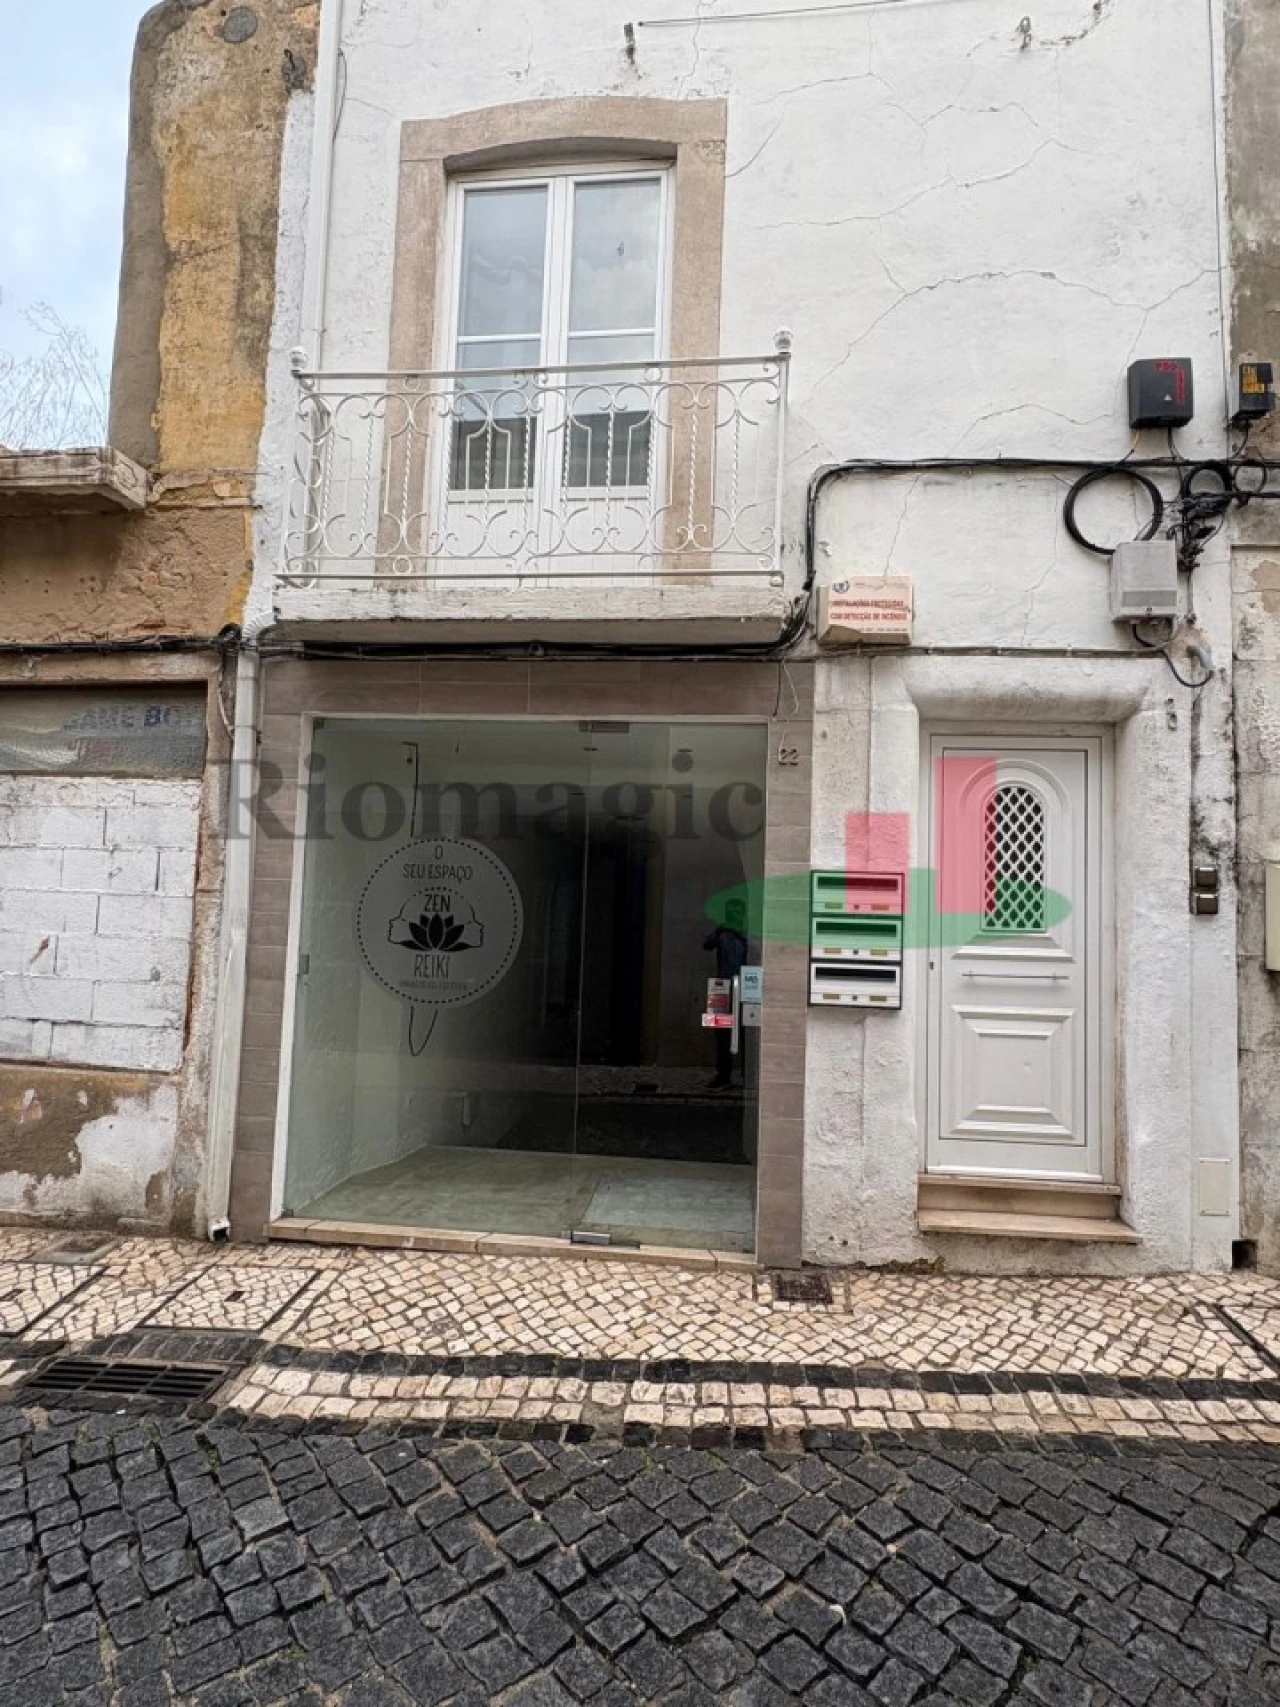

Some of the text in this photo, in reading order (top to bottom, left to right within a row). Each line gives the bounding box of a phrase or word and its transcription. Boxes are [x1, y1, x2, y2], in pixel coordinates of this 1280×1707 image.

[435, 845, 443, 860] O
[403, 864, 473, 882] SEU ESPAÇO
[424, 893, 451, 913] ZEN
[413, 954, 450, 979] REIKI
